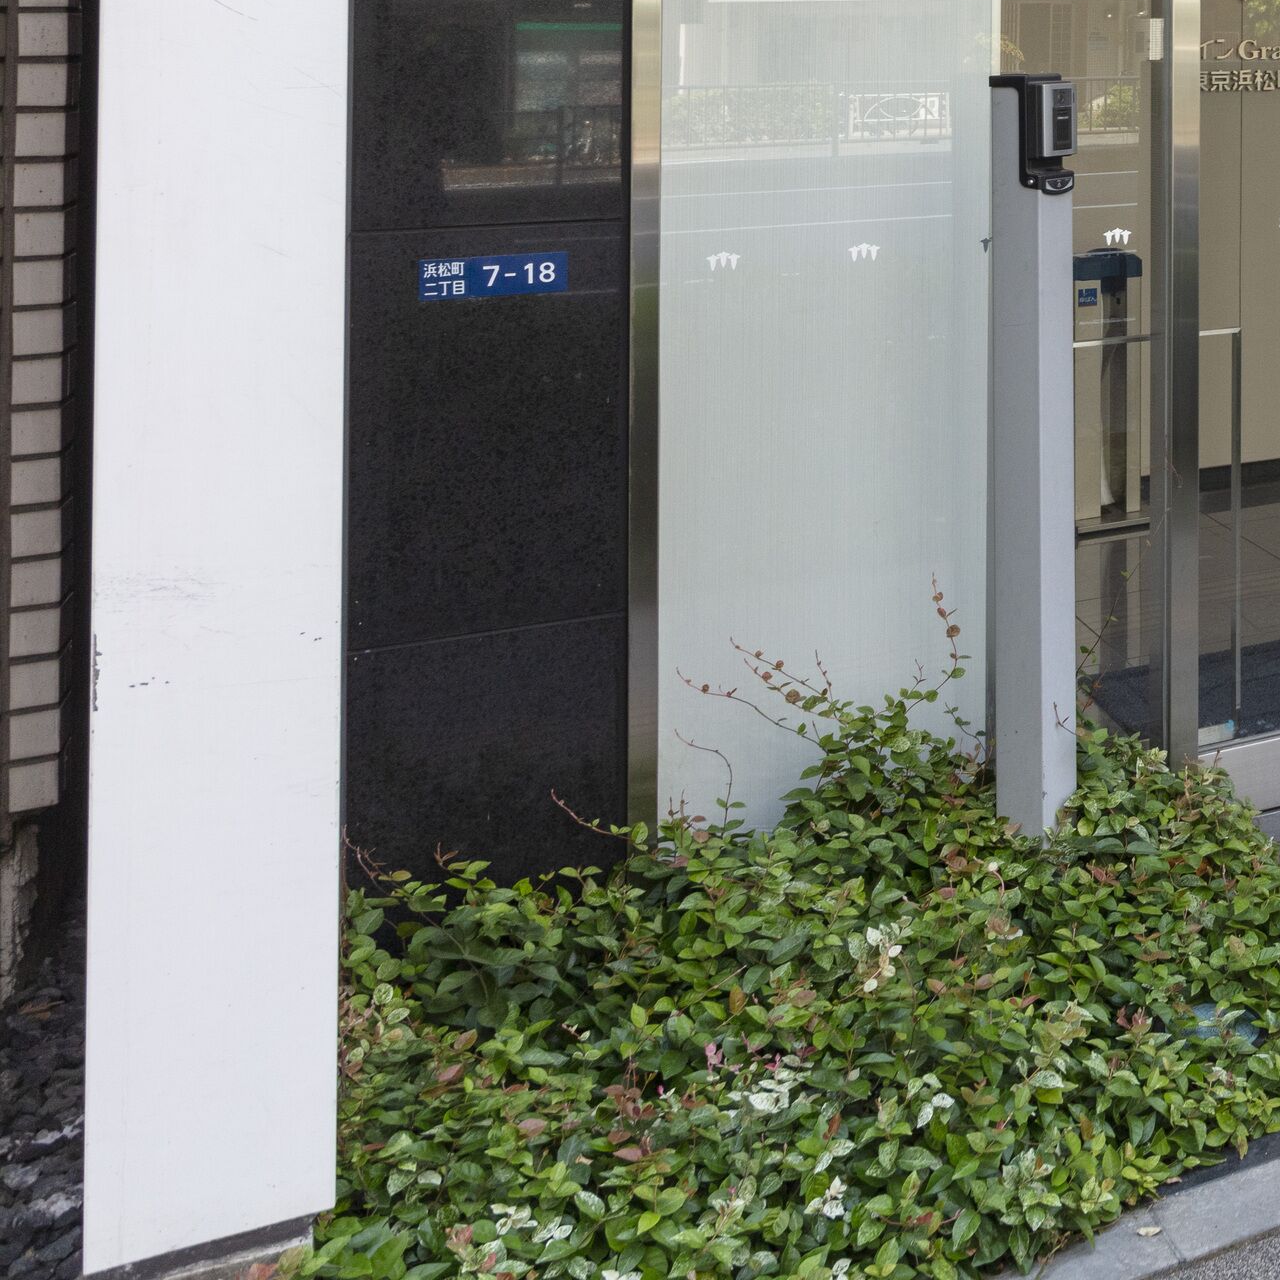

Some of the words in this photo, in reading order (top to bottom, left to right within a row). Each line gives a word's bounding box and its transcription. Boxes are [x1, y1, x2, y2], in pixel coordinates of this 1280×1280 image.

[423, 261, 465, 278] 浜松町
[482, 261, 556, 287] 7-18
[423, 279, 466, 296] 二丁目
